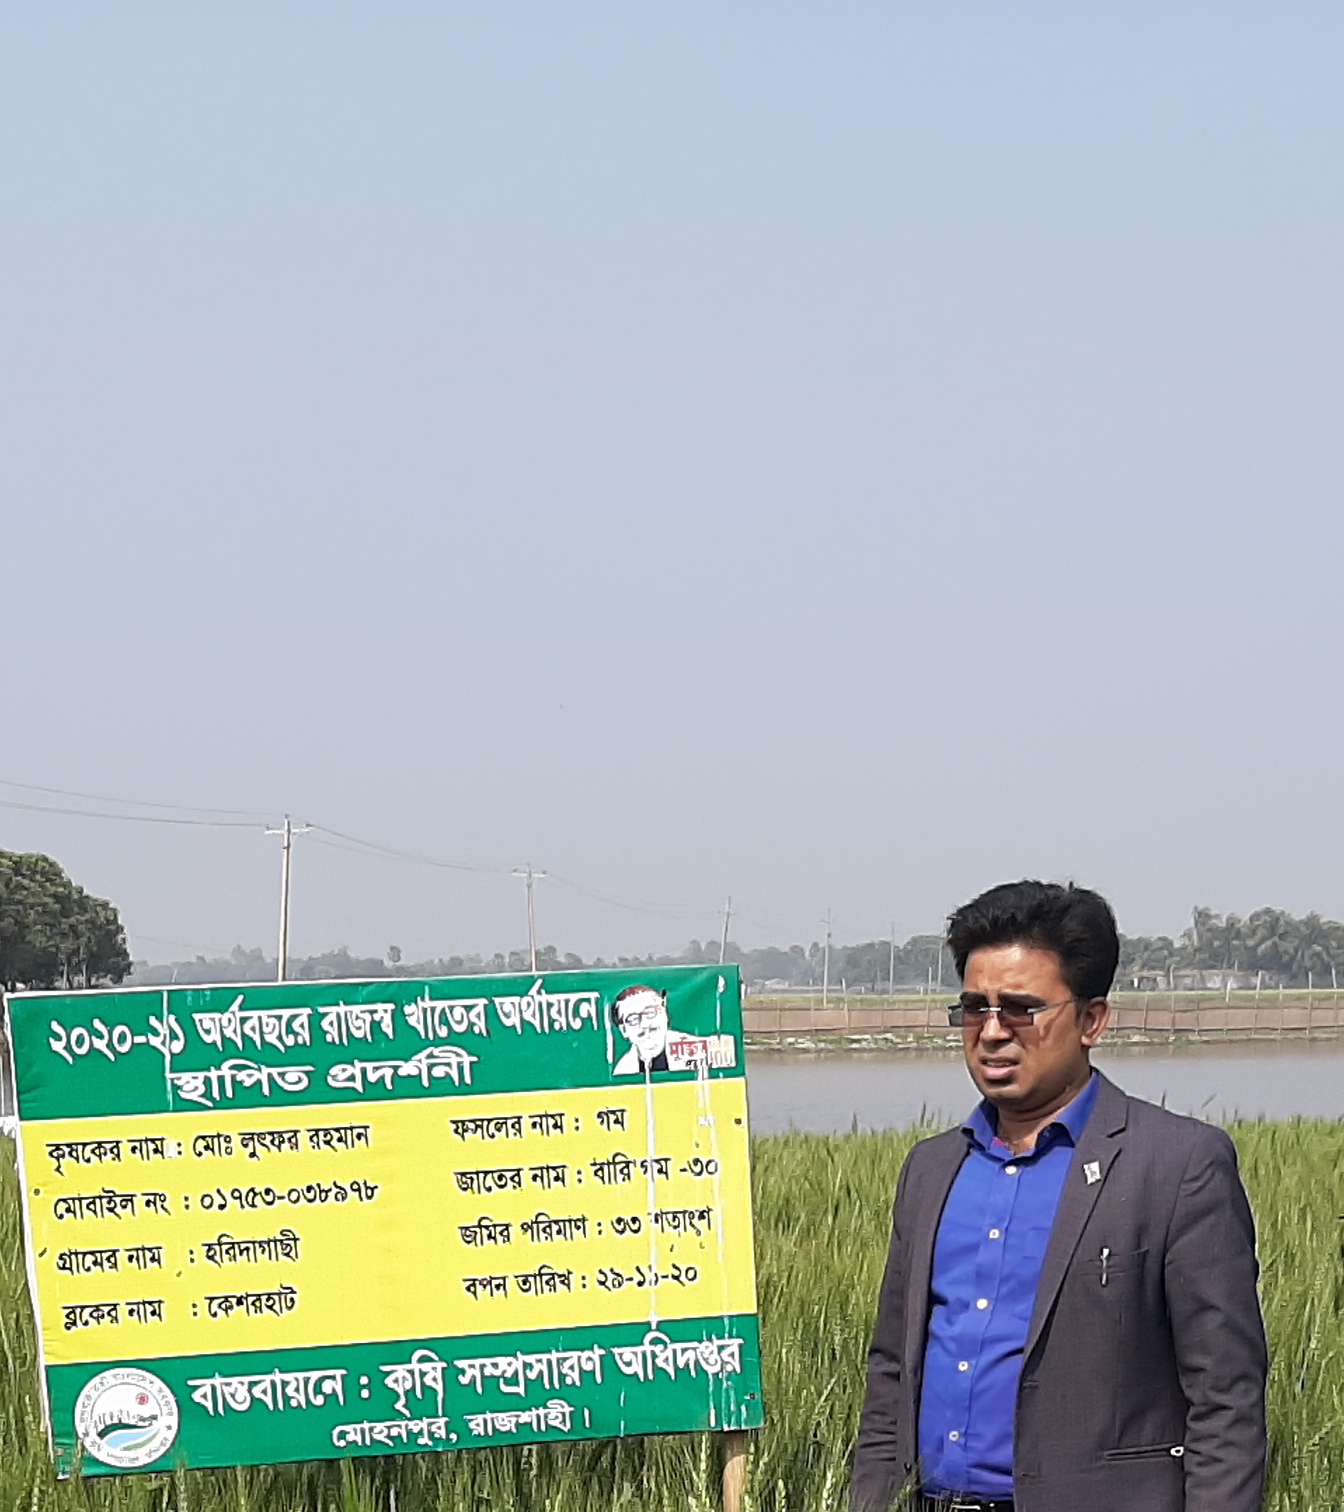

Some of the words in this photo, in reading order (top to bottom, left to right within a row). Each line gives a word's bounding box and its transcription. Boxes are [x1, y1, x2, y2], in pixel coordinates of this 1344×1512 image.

[49, 1014, 185, 1064] ২০২০-২১
[192, 994, 312, 1053] অর্থবছরে
[317, 1001, 395, 1046] রাজস্ব
[404, 985, 490, 1041] খাতের
[492, 978, 600, 1035] অর্থায়নে
[168, 1058, 315, 1107] স্থাপিত
[327, 1045, 479, 1093] প্রদর্শনী
[451, 1115, 523, 1141] ফসলের
[529, 1111, 565, 1137] নাম
[598, 1107, 627, 1132] গম
[46, 1139, 121, 1176] কৃষকের
[127, 1137, 166, 1161] নাম
[193, 1133, 233, 1158] মোঃ
[238, 1130, 300, 1159] লুৎফর
[307, 1123, 370, 1151] রহমান
[455, 1167, 523, 1194] জাতের
[529, 1164, 567, 1190] নাম
[53, 1186, 136, 1220] মোবাইল
[142, 1193, 171, 1219] নং
[459, 1217, 511, 1247] জমির
[520, 1212, 587, 1242] পরিমাণ
[611, 1214, 642, 1235] ৩৩
[56, 1248, 119, 1276] গ্রামের
[125, 1245, 163, 1270] নাম
[202, 1230, 299, 1267] হরিদাগাছী
[462, 1274, 507, 1300] বপন
[514, 1264, 573, 1297] তারিখ
[62, 1301, 119, 1330] ব্লকের
[126, 1299, 164, 1324] নাম
[204, 1284, 297, 1318] কেশরহাট
[187, 1368, 347, 1417] বাস্তবায়নে
[379, 1349, 449, 1418] কৃষি
[454, 1344, 606, 1397] সম্প্রসারণ
[610, 1331, 744, 1383] অধিদপ্তর
[463, 1399, 575, 1437] রাজশাহী
